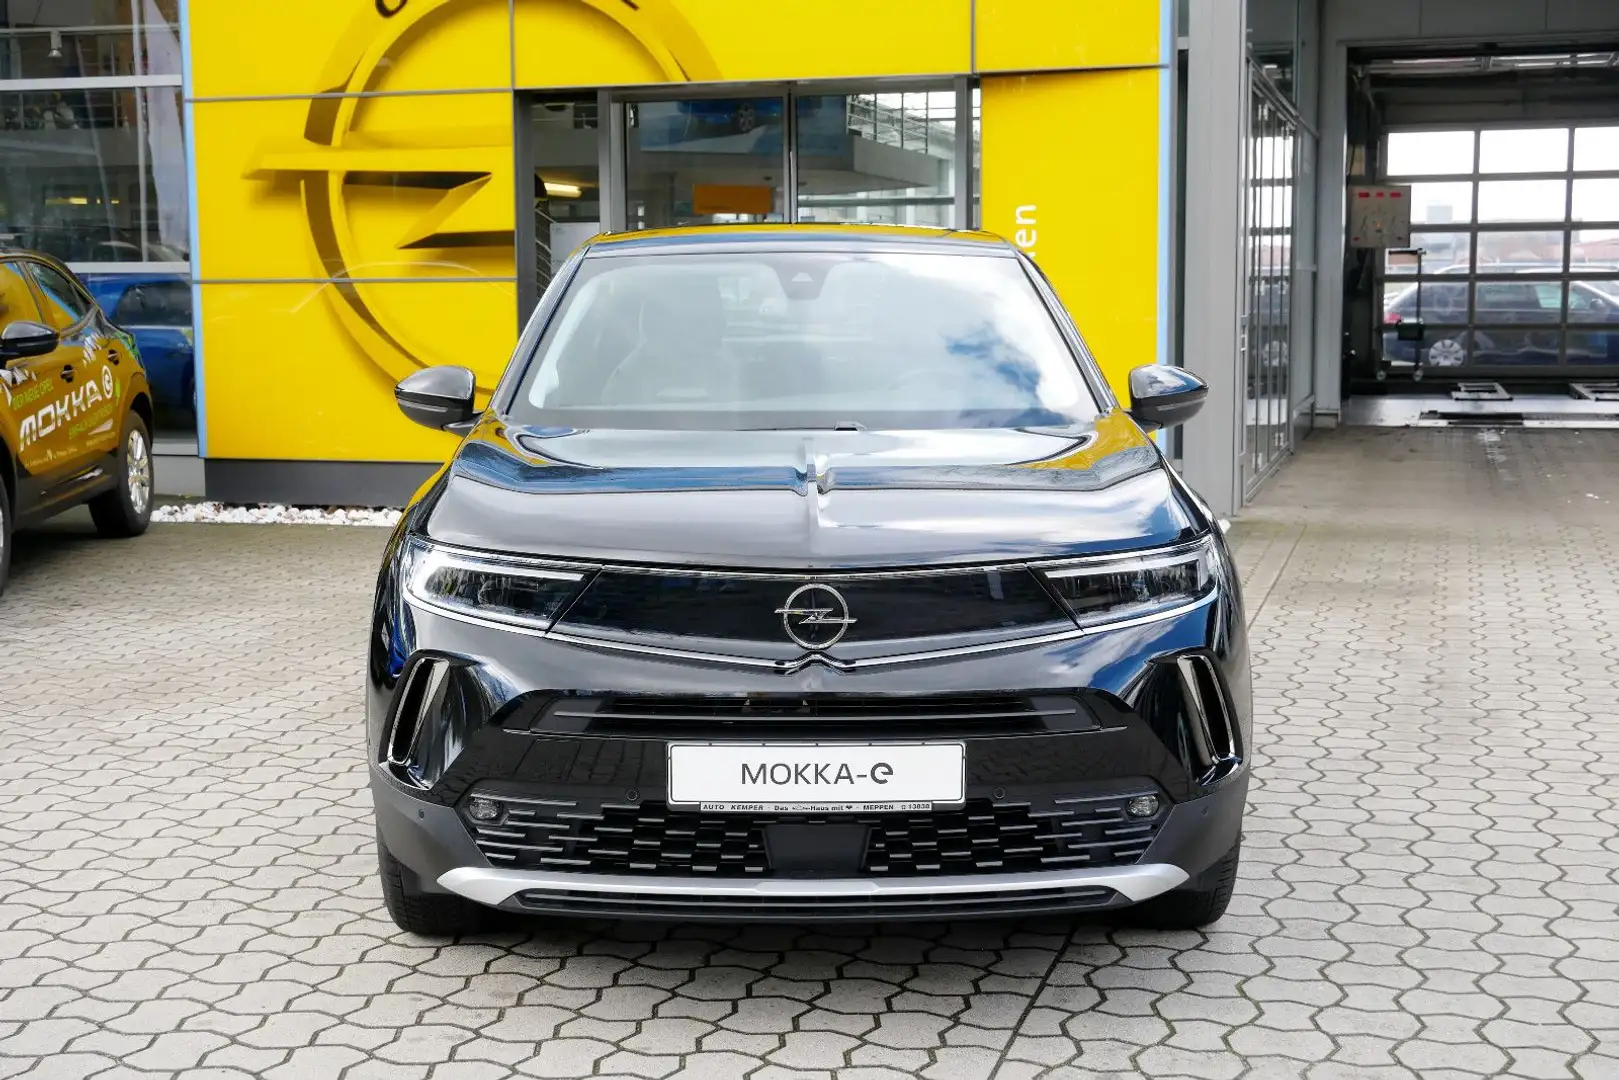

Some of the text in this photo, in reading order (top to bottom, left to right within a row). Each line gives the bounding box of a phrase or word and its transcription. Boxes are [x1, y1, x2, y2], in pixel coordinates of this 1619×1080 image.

[1015, 205, 1037, 258] en
[20, 380, 102, 452] MOKKA
[741, 762, 894, 785] MOKKA-e
